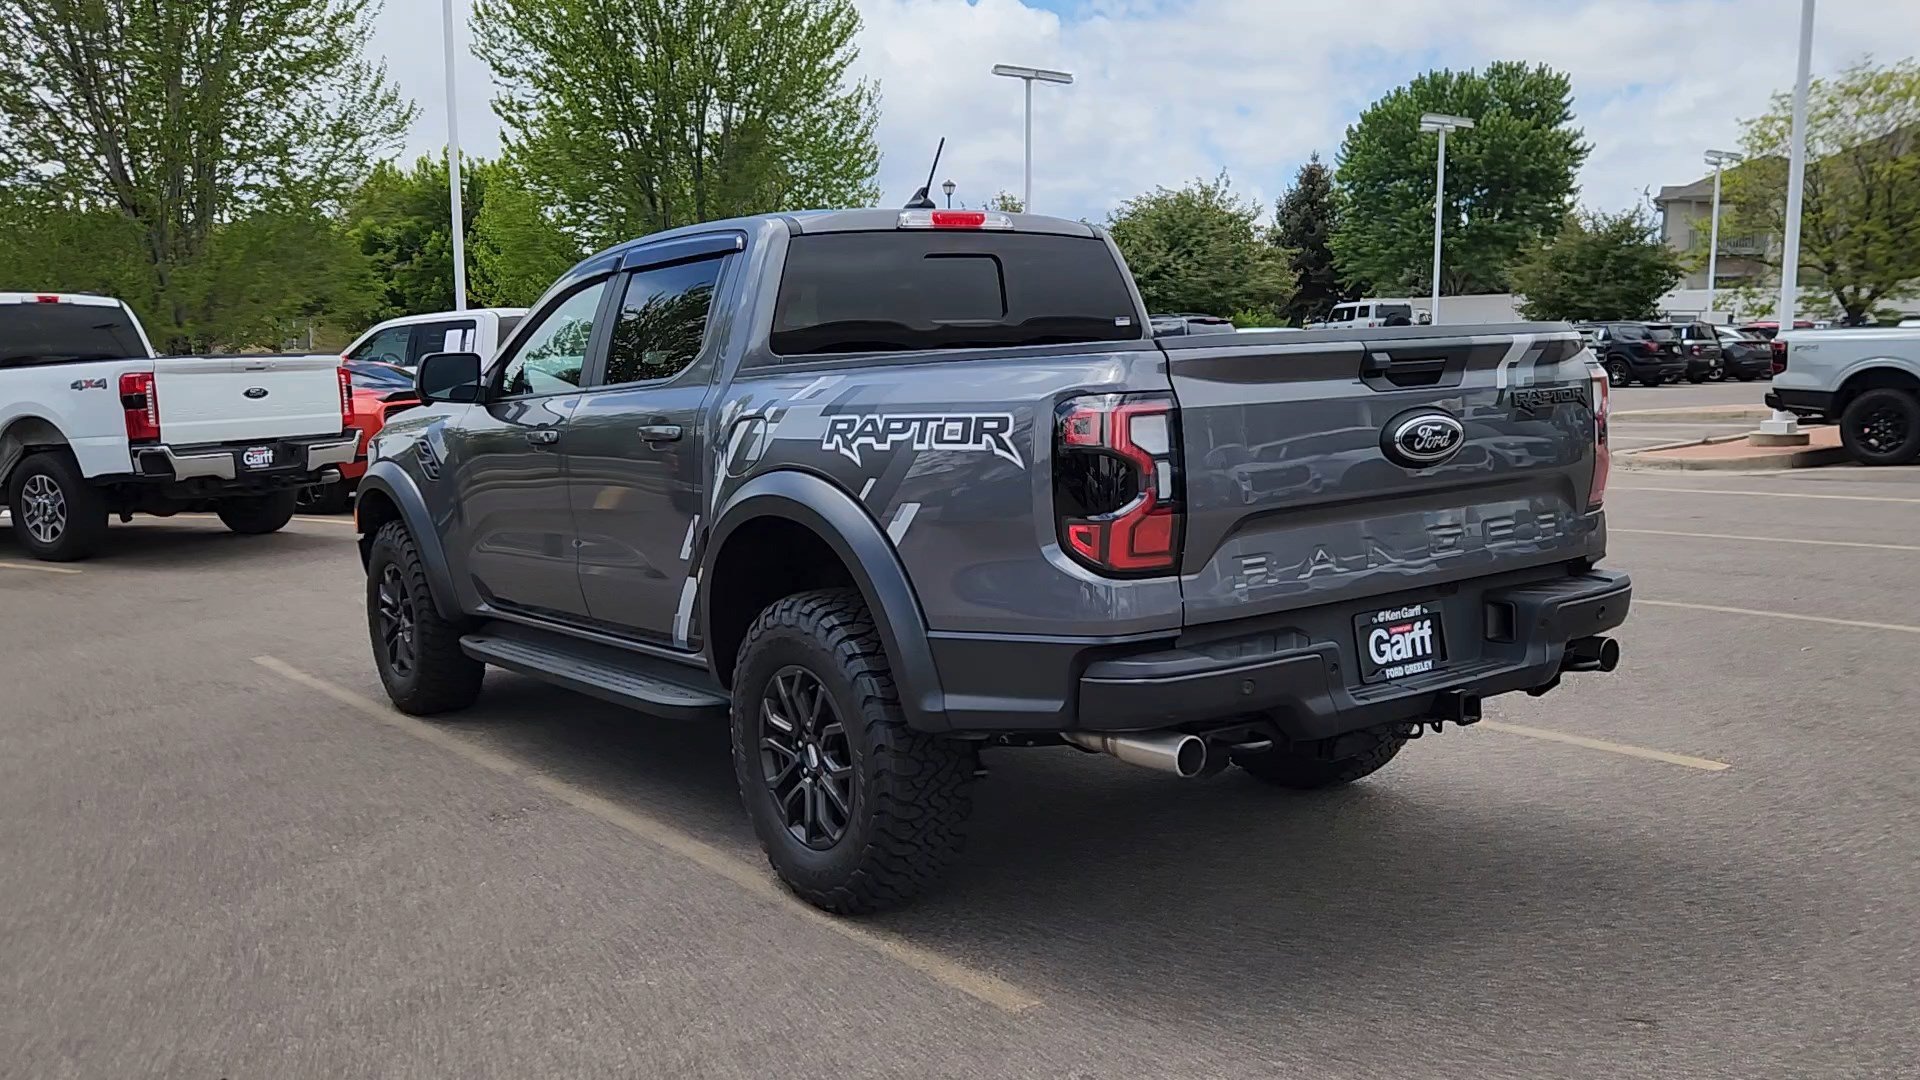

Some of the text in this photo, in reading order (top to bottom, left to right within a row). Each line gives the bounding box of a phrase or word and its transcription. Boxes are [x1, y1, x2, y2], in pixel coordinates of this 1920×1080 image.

[1510, 386, 1588, 416] RAPTOR
[821, 413, 1026, 470] RAPTOR
[1414, 424, 1451, 450] Ford
[243, 449, 273, 466] Garff
[1231, 509, 1564, 589] RANGER
[1401, 605, 1421, 619] Garff
[1368, 619, 1432, 665] Garff
[1385, 666, 1404, 679] FORD
